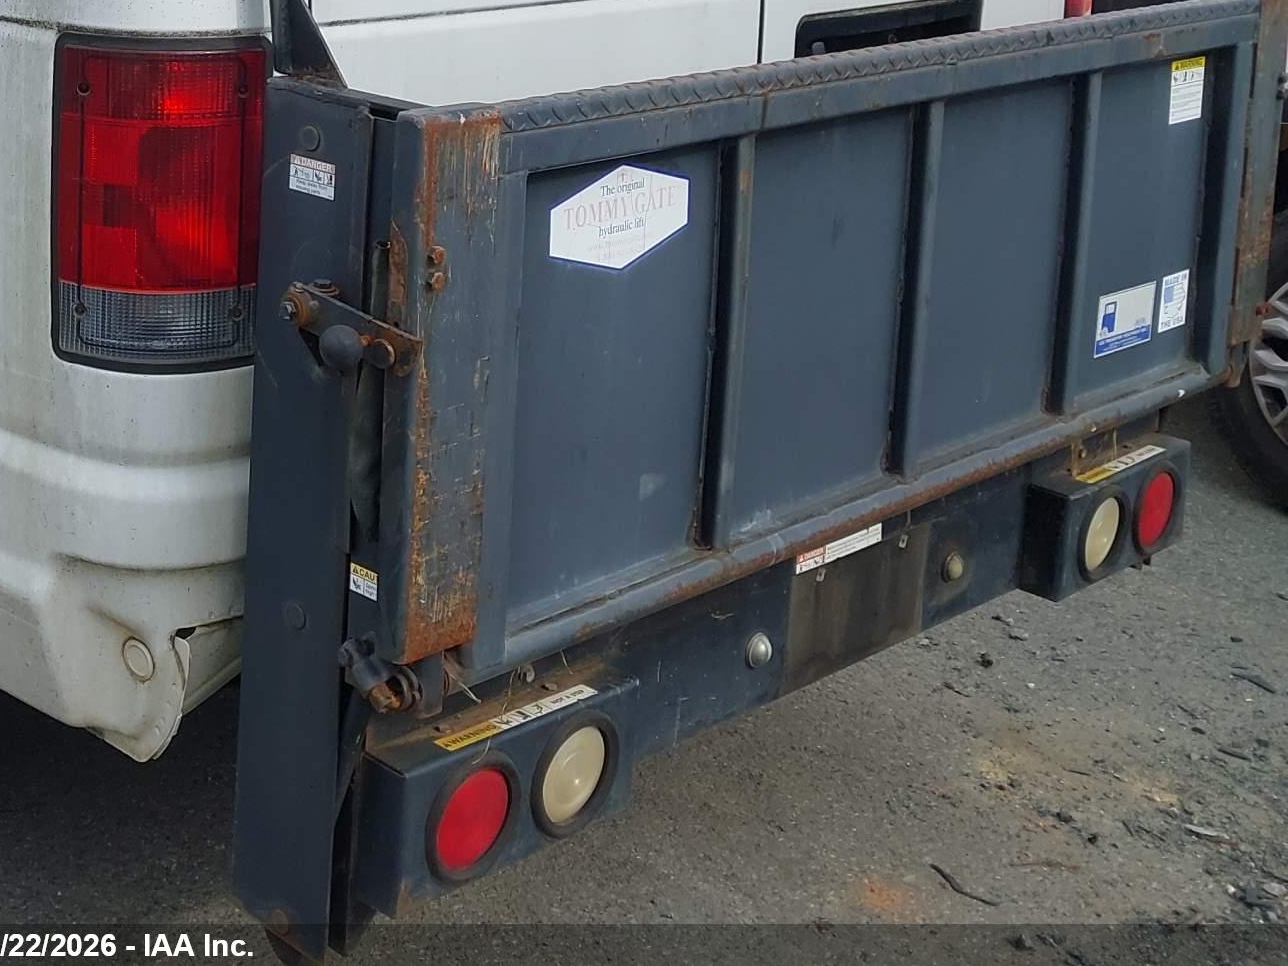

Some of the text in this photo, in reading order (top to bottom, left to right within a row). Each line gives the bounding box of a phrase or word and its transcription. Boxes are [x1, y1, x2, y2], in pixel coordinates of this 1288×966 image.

[600, 178, 645, 197] The original
[564, 186, 676, 231] TOMMY GATE
[599, 217, 645, 239] hydraulic lift
